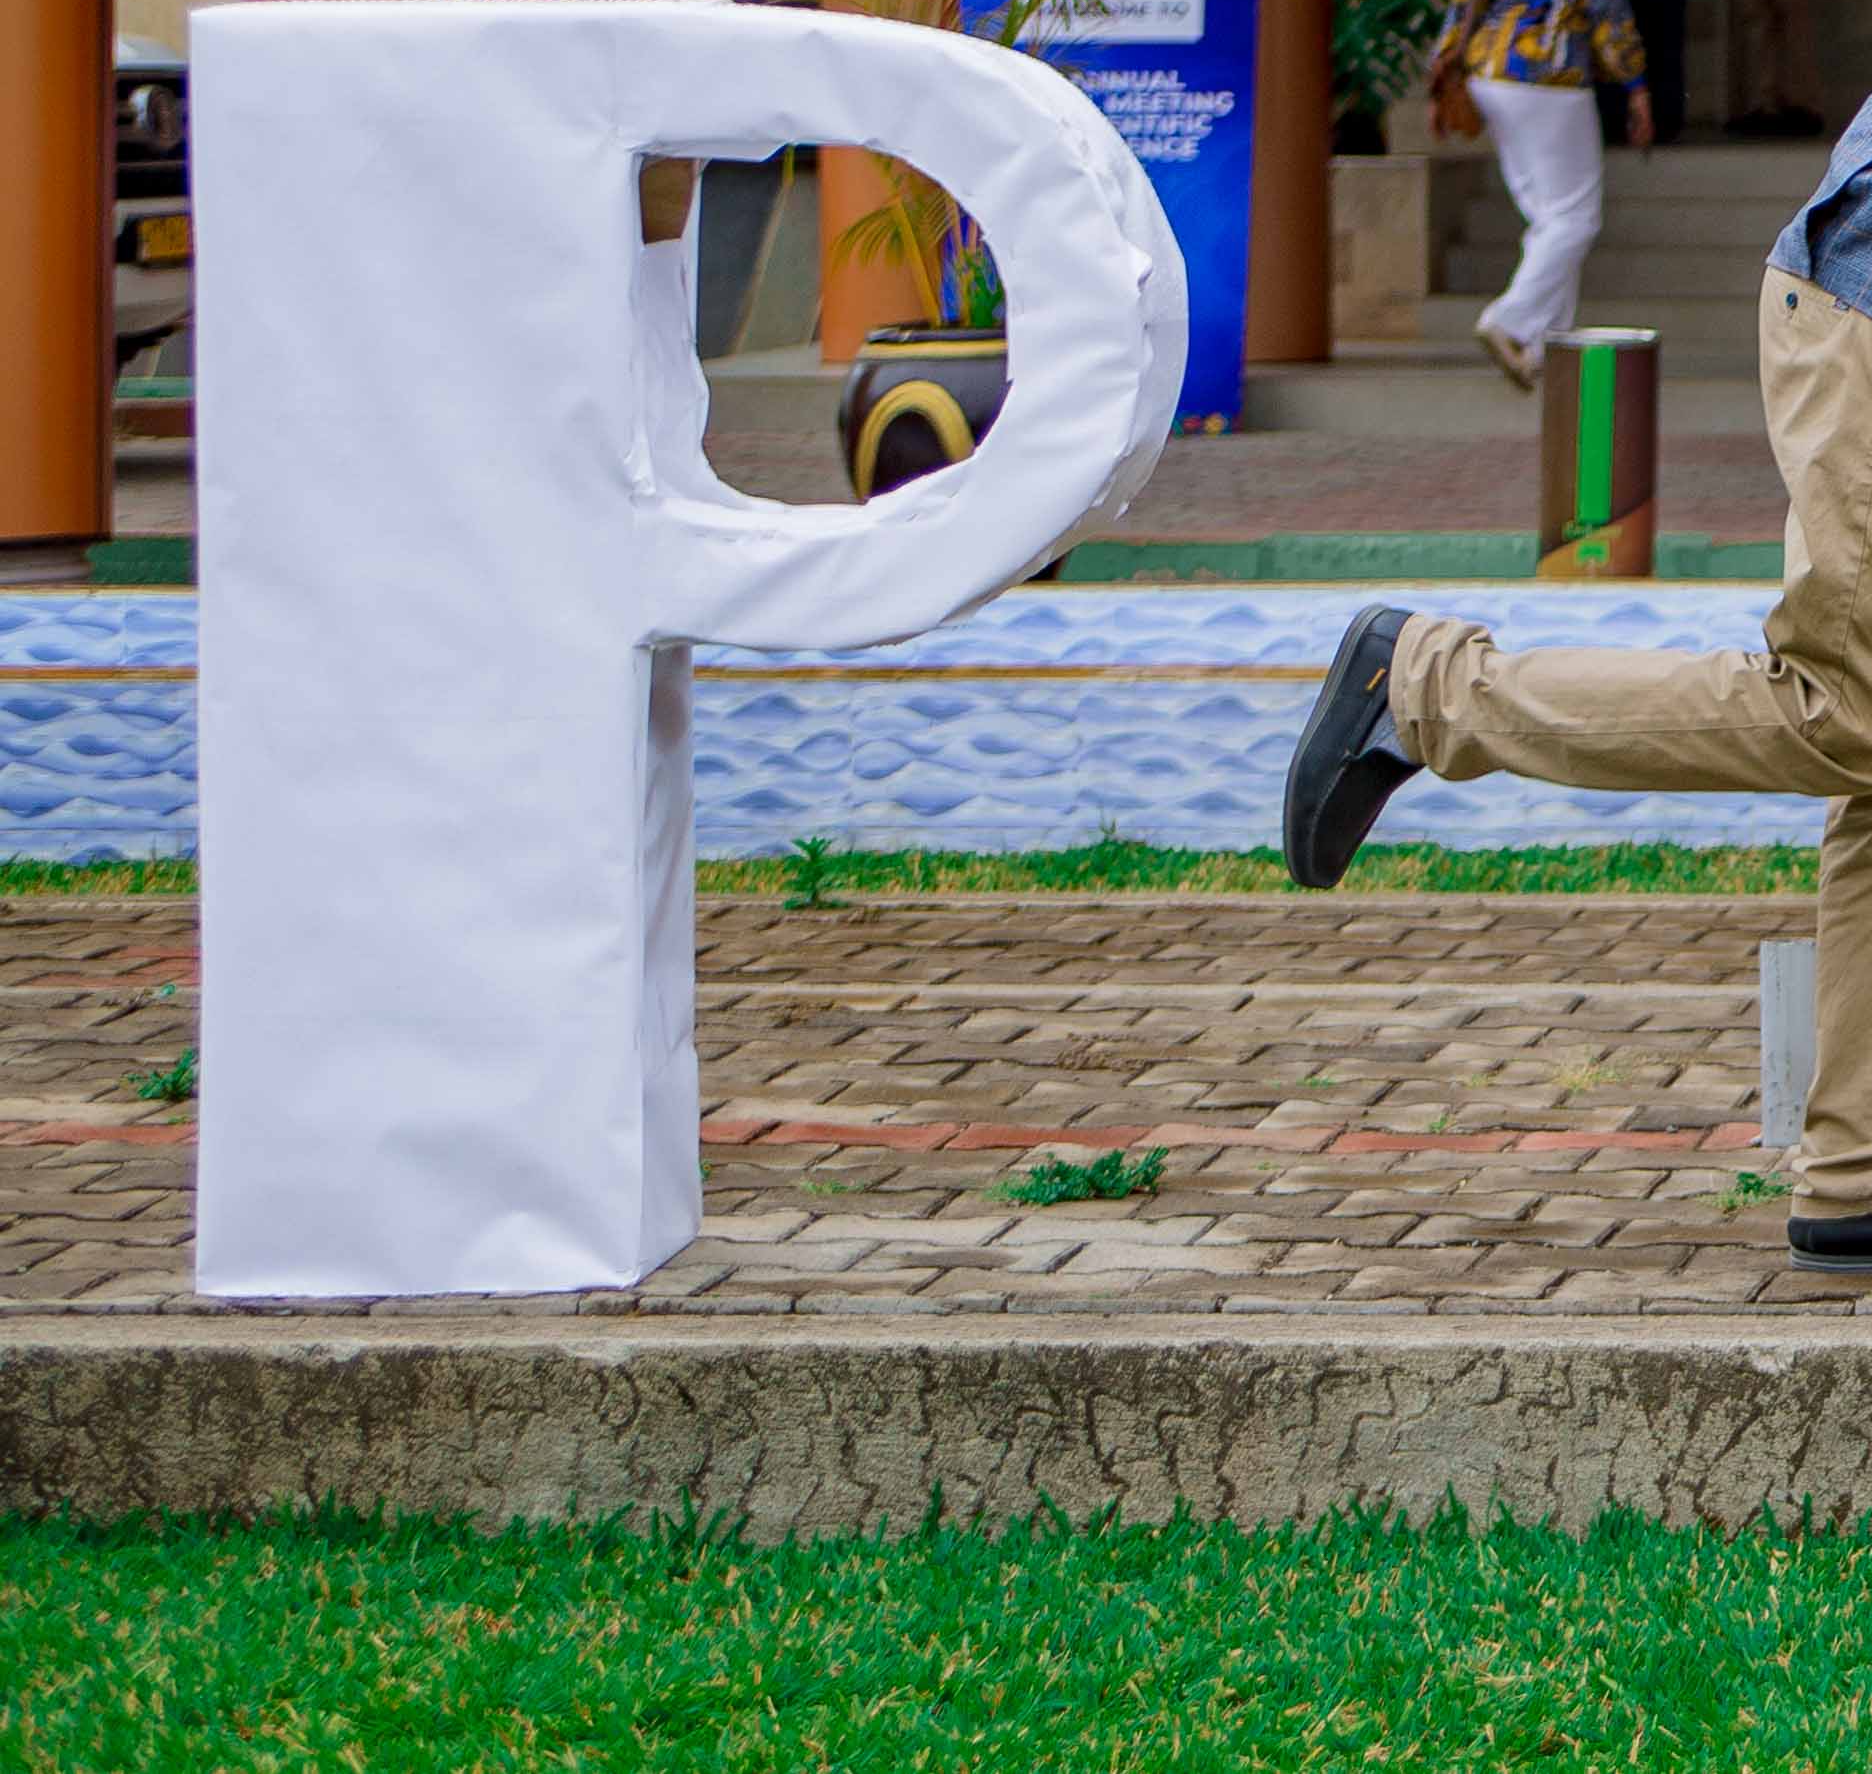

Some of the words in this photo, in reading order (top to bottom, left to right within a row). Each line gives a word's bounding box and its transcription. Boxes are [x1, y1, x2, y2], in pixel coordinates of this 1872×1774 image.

[1103, 91, 1236, 118] MEETING
[1106, 113, 1213, 140] ENTIFIC
[1124, 134, 1201, 162] ENCE
